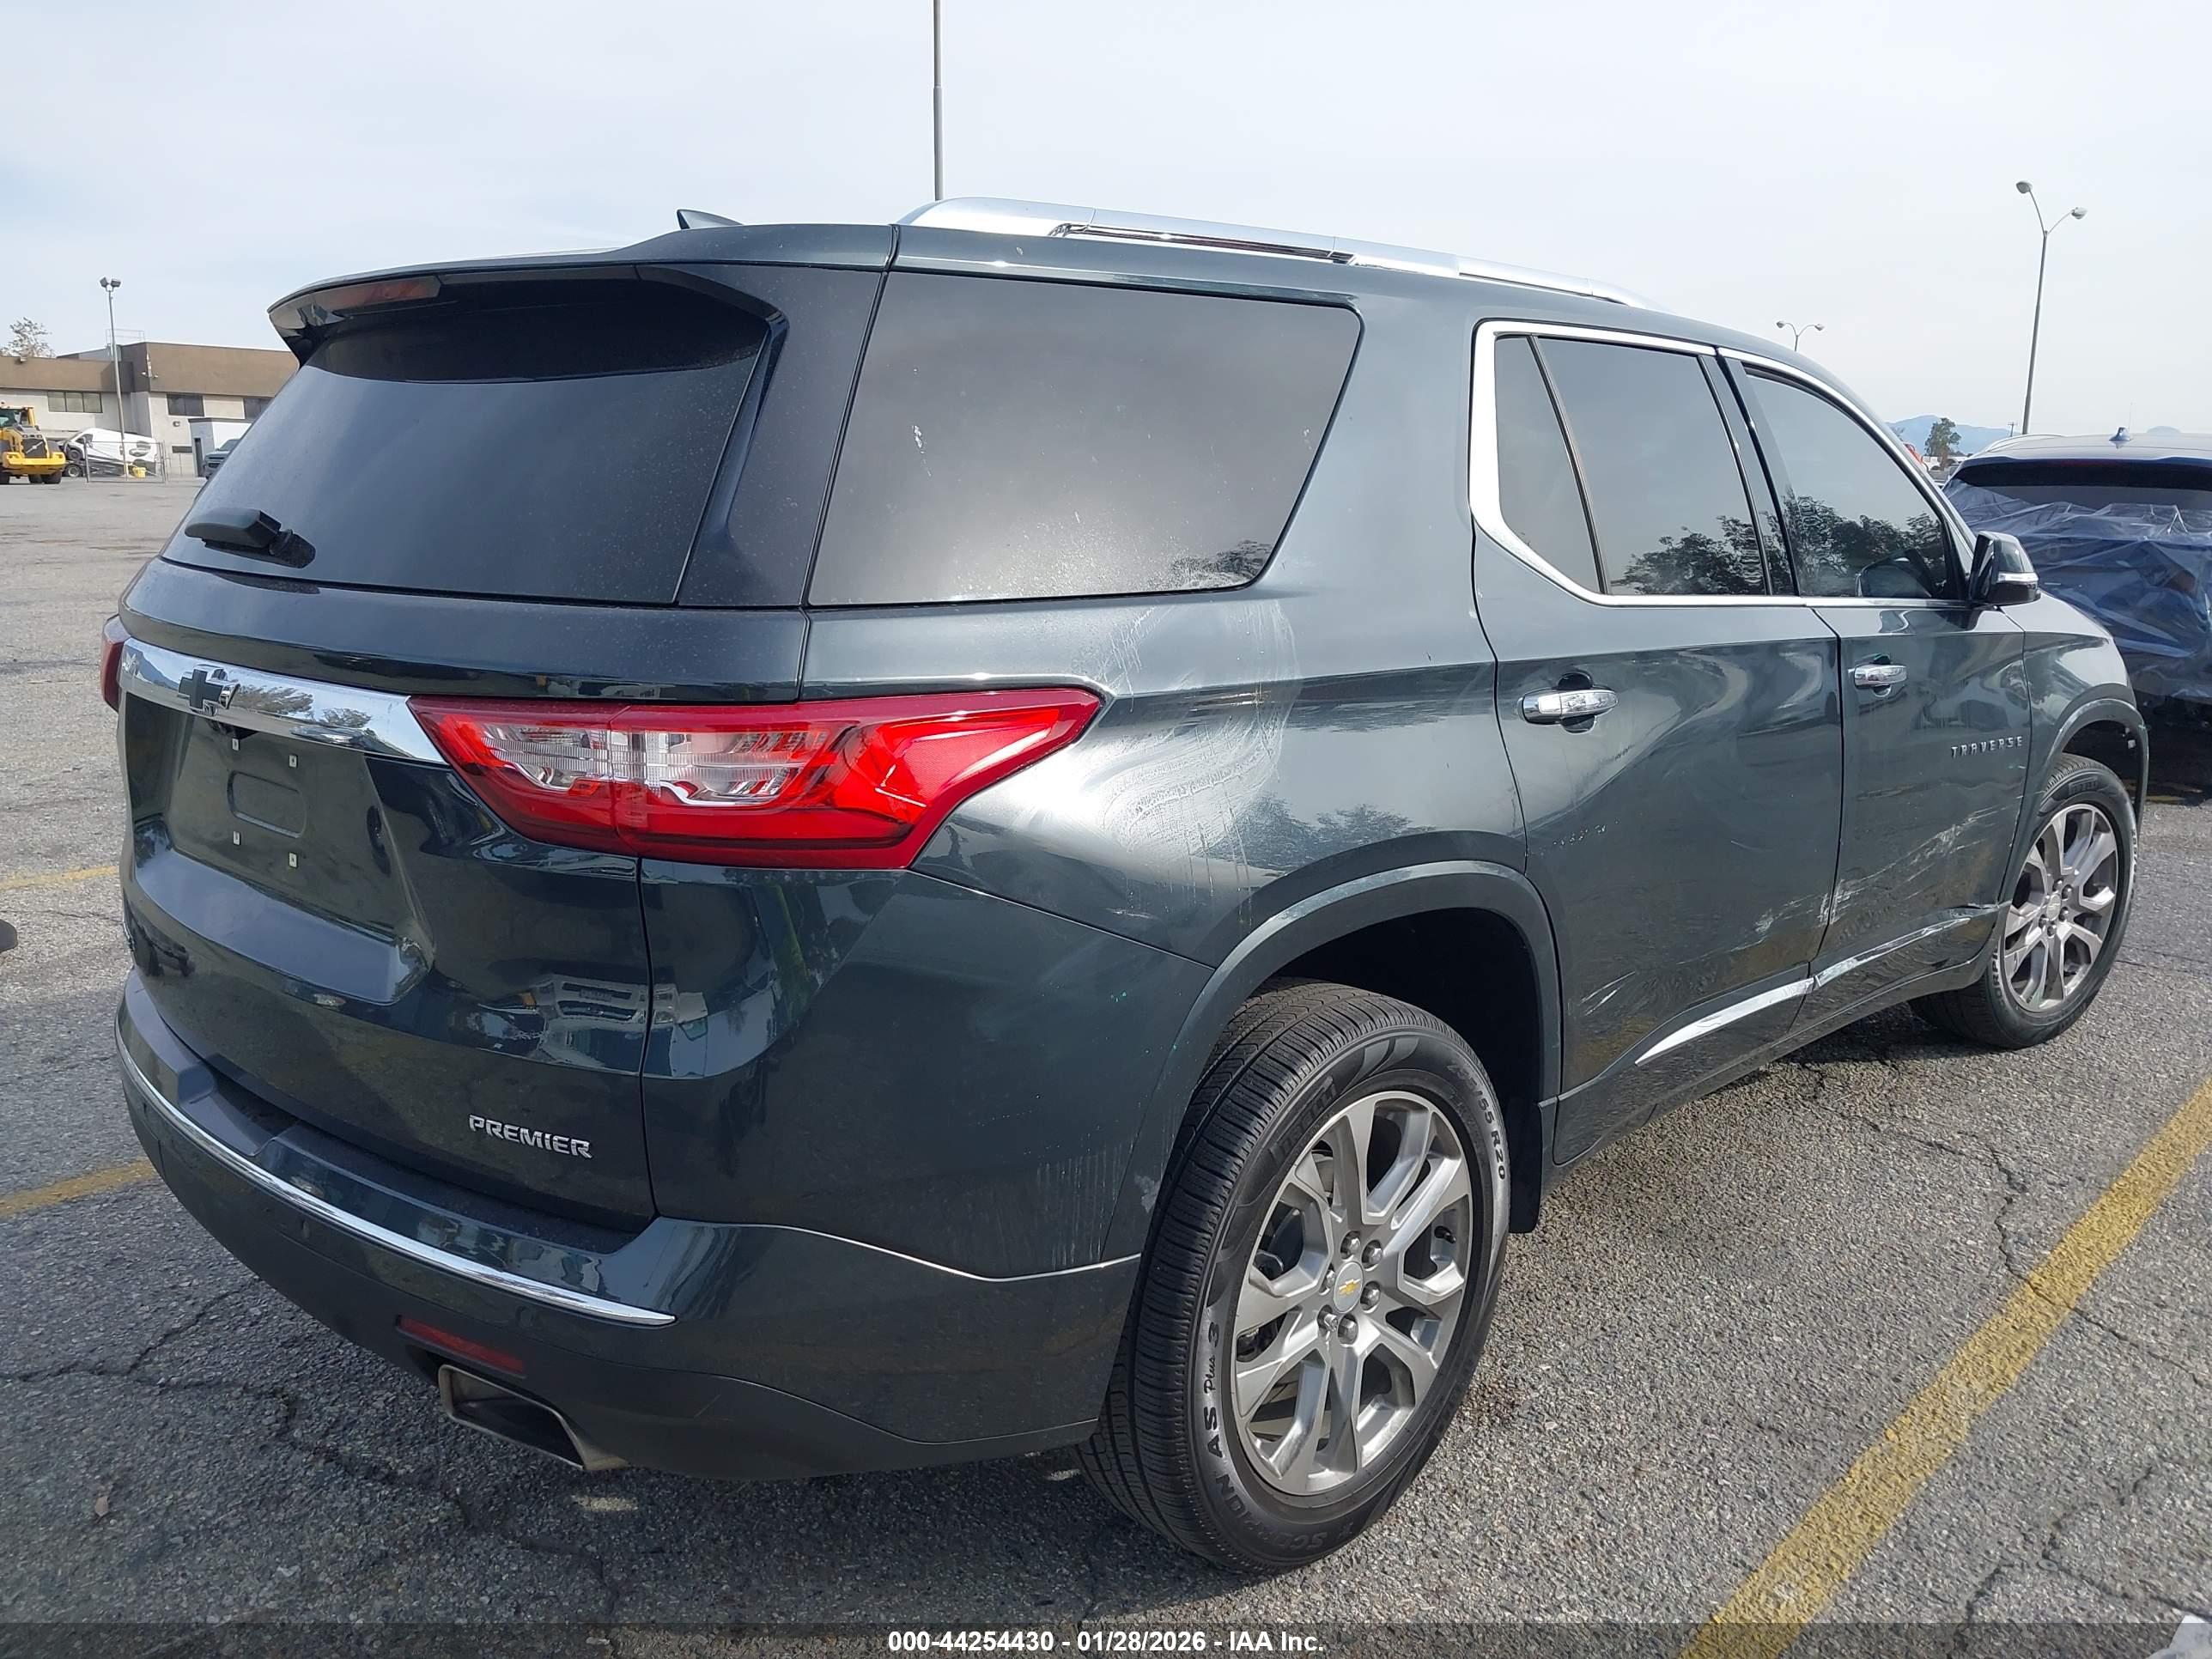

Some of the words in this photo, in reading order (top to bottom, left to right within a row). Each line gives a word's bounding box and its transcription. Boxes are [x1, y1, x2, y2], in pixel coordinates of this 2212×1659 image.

[1950, 735, 2023, 759] TRAVERSE
[468, 1114, 592, 1158] PREMIER
[1491, 1129, 1506, 1181] R20
[1207, 1321, 1220, 1349] 3
[1203, 1354, 1217, 1395] Plus
[1203, 1406, 1224, 1459] AS
